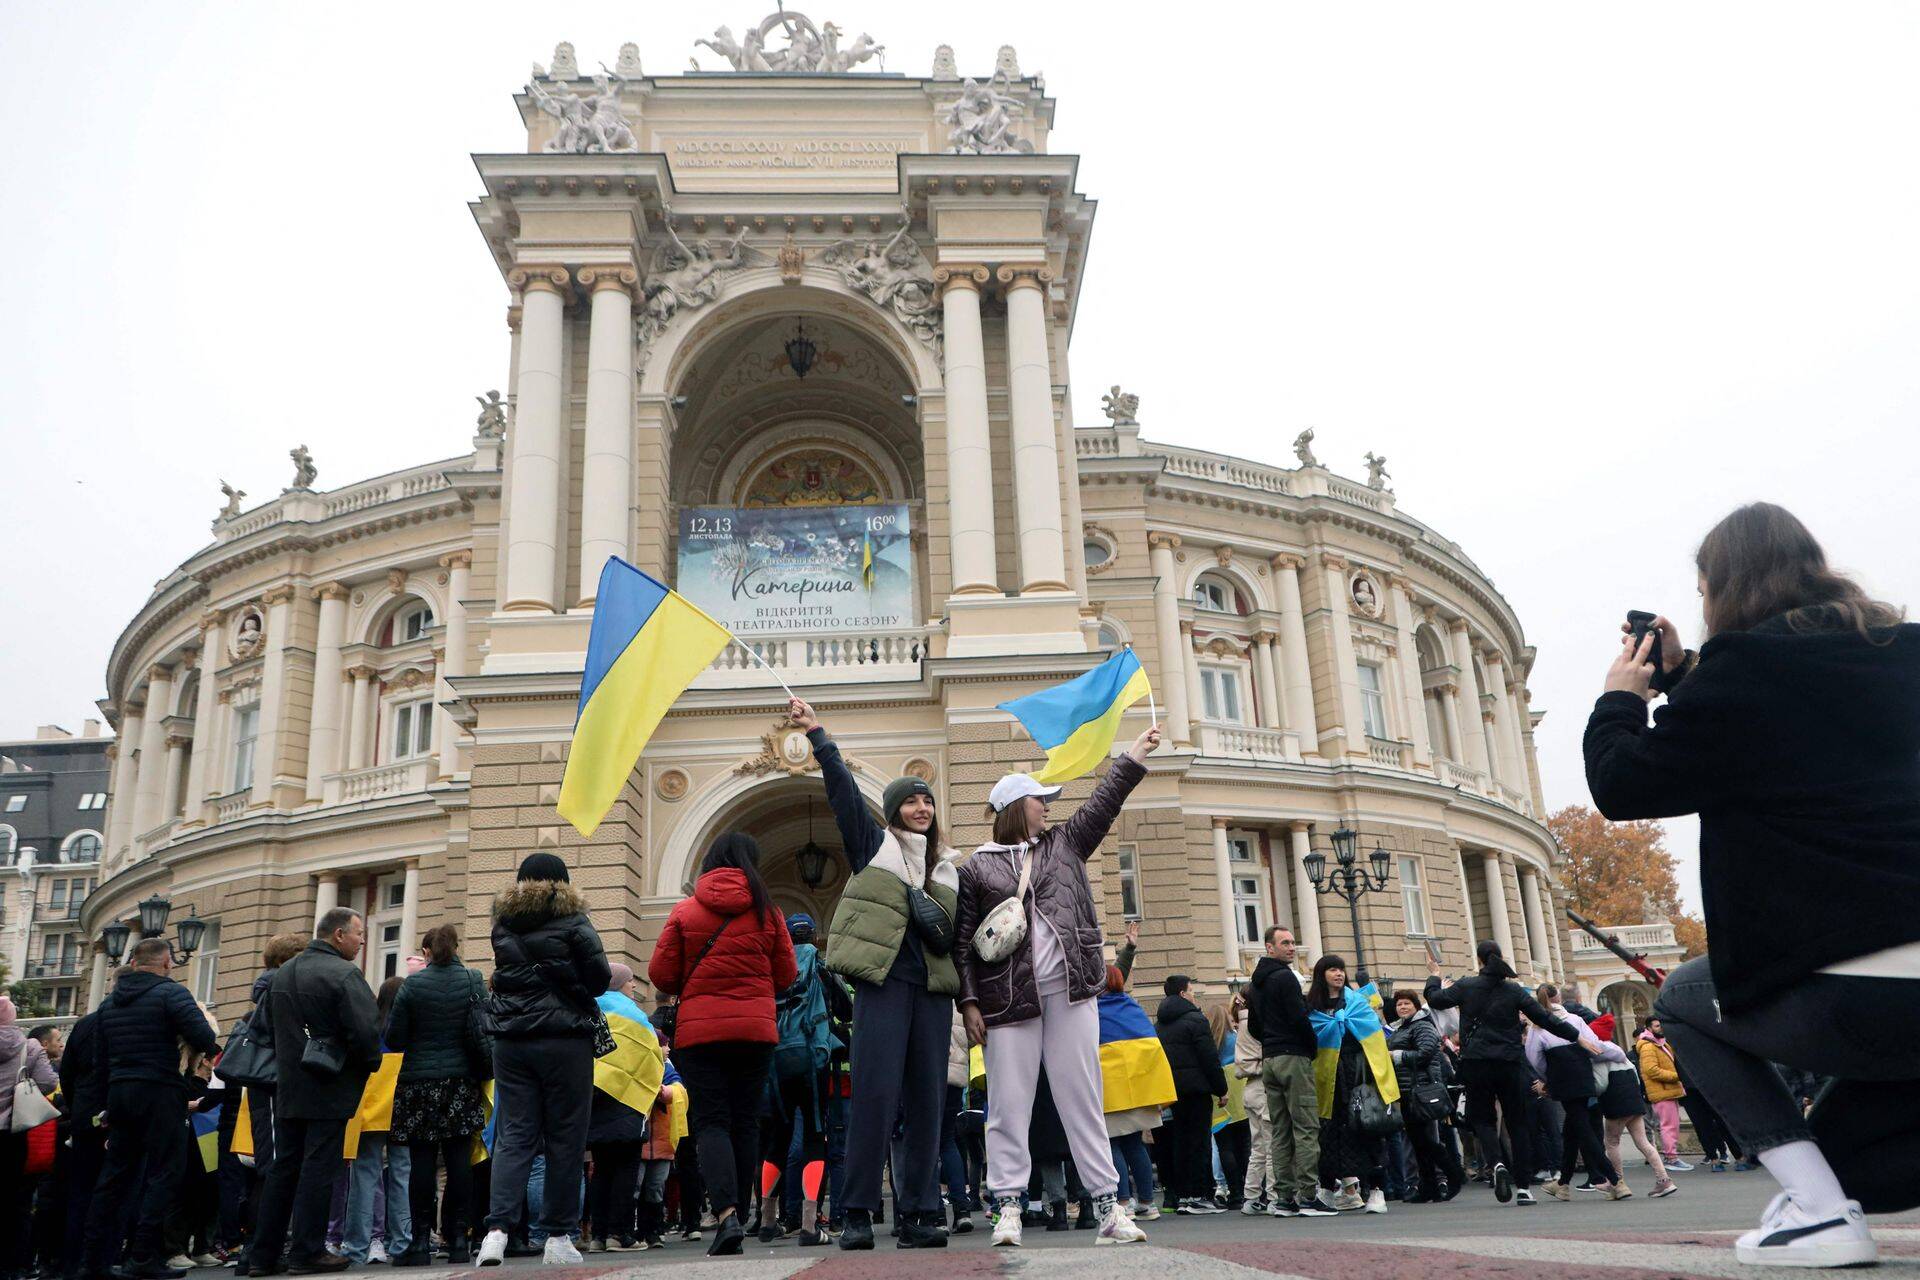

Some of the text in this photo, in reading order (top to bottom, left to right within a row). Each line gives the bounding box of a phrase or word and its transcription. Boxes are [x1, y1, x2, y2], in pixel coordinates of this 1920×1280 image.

[731, 567, 857, 604] Катерина
[756, 606, 833, 617] ВІДКРИТТЯ
[734, 617, 840, 631] ТЕАТРАЛЬНОГО
[844, 615, 900, 627] СЕЗОНУ
